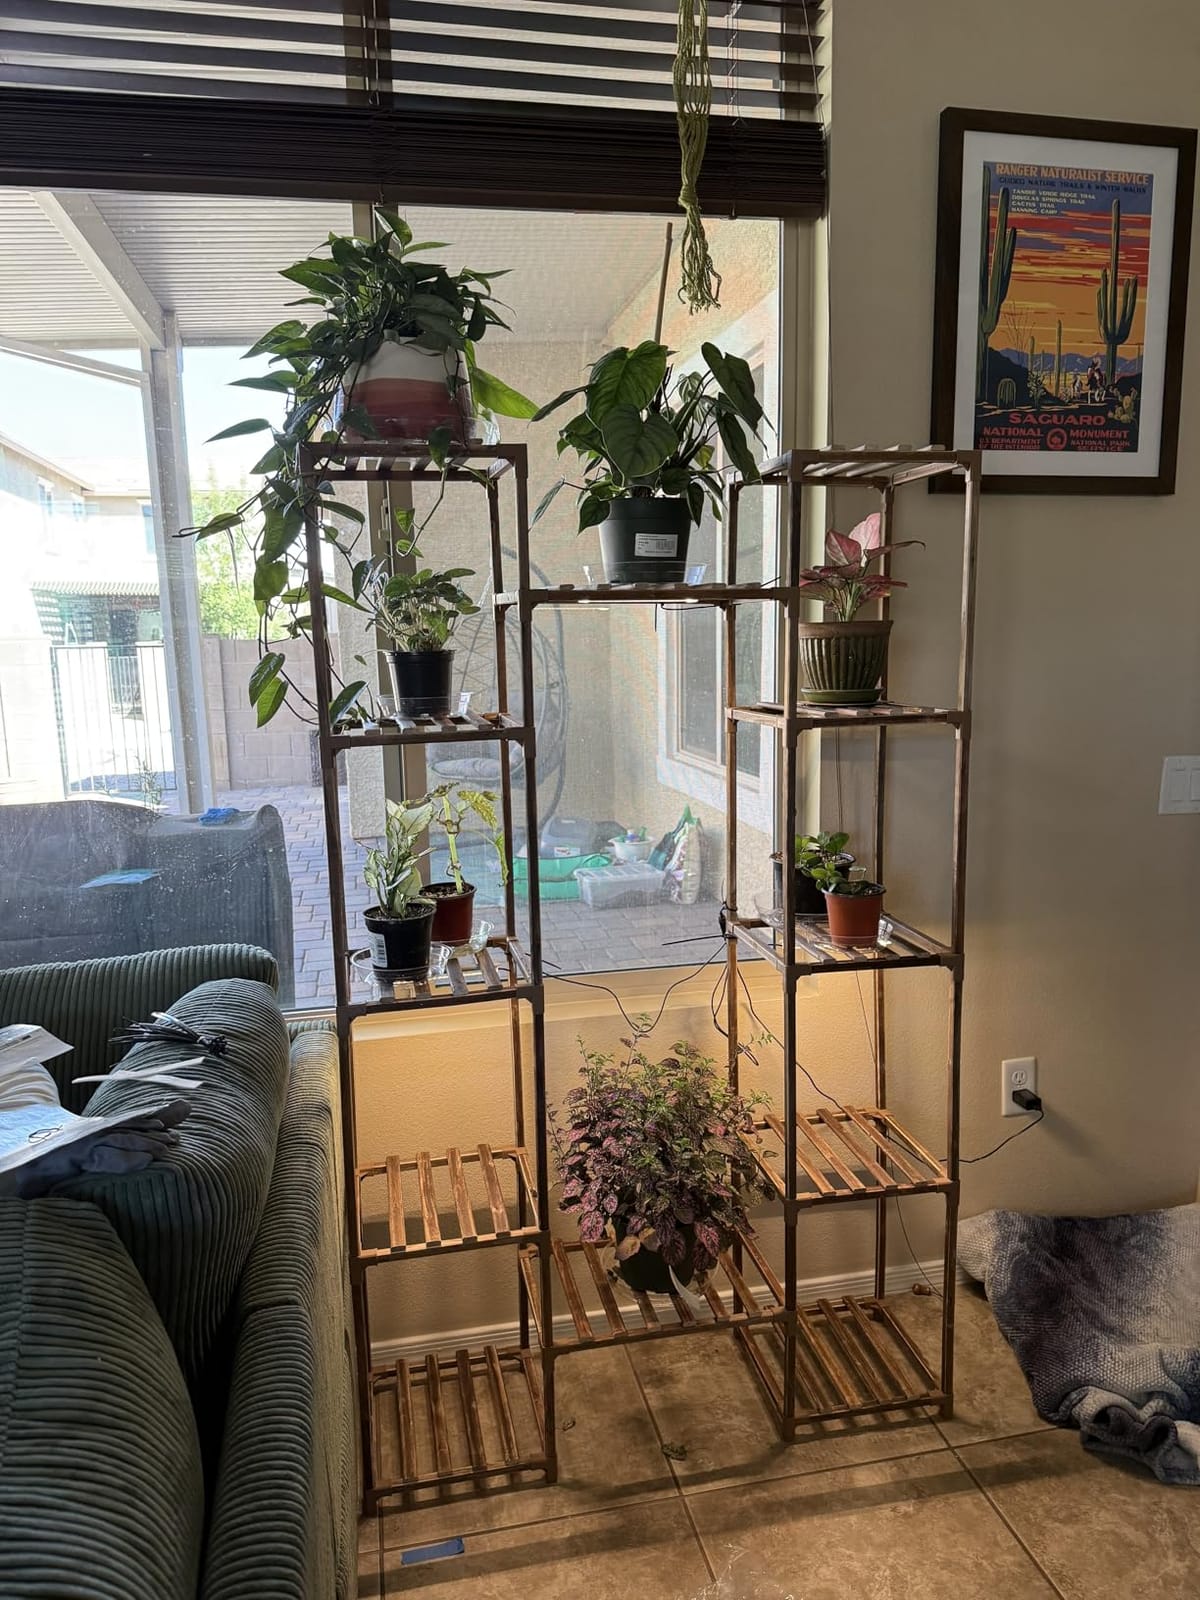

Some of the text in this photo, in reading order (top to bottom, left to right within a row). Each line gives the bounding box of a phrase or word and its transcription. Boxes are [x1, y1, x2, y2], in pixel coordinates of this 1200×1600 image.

[996, 164, 1149, 184] RANGER NATURALIST SERVICE
[1008, 412, 1106, 426] SAGUARO
[984, 427, 1130, 438] NATIONAL MONUMENT
